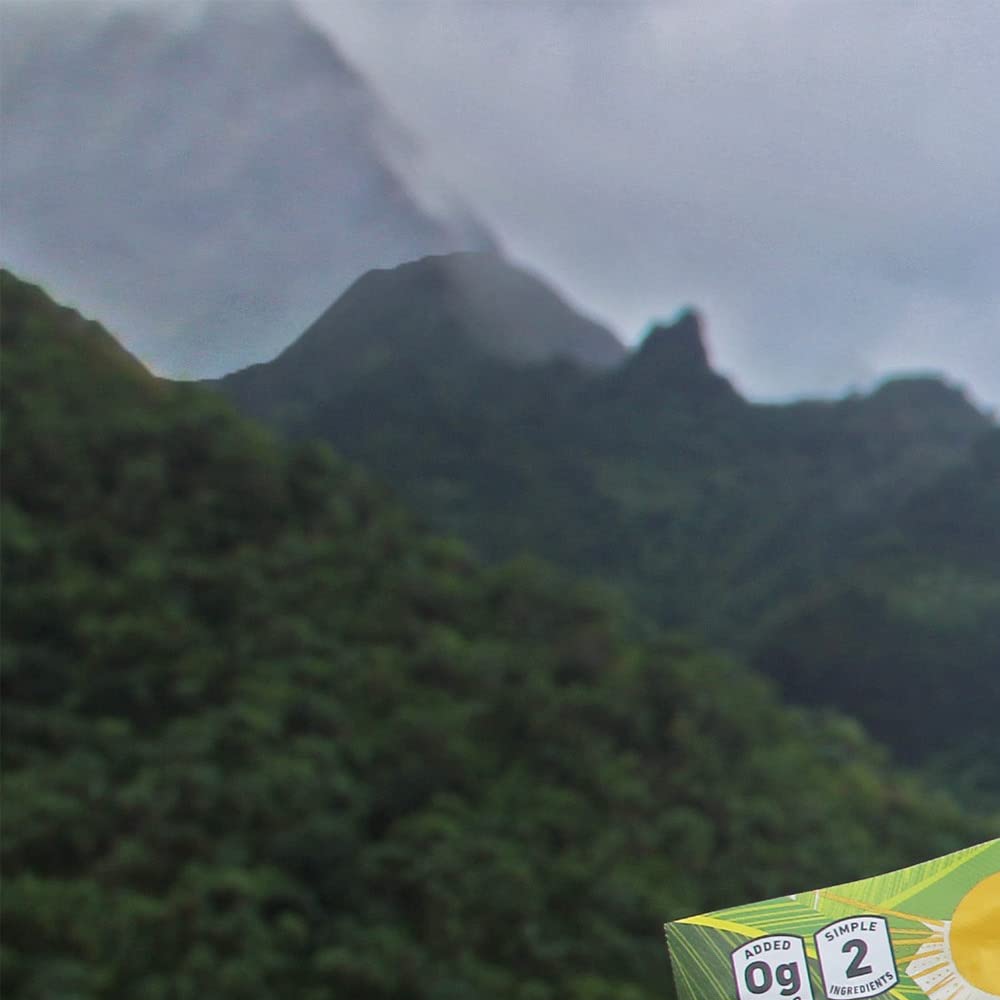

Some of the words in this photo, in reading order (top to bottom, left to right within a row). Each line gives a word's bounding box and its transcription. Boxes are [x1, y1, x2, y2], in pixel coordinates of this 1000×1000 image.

[825, 921, 878, 942] SIMPLE
[744, 940, 791, 960] ADDED
[841, 938, 873, 978] 2
[744, 960, 801, 996] 0g
[829, 971, 894, 996] INGREDIENTS
